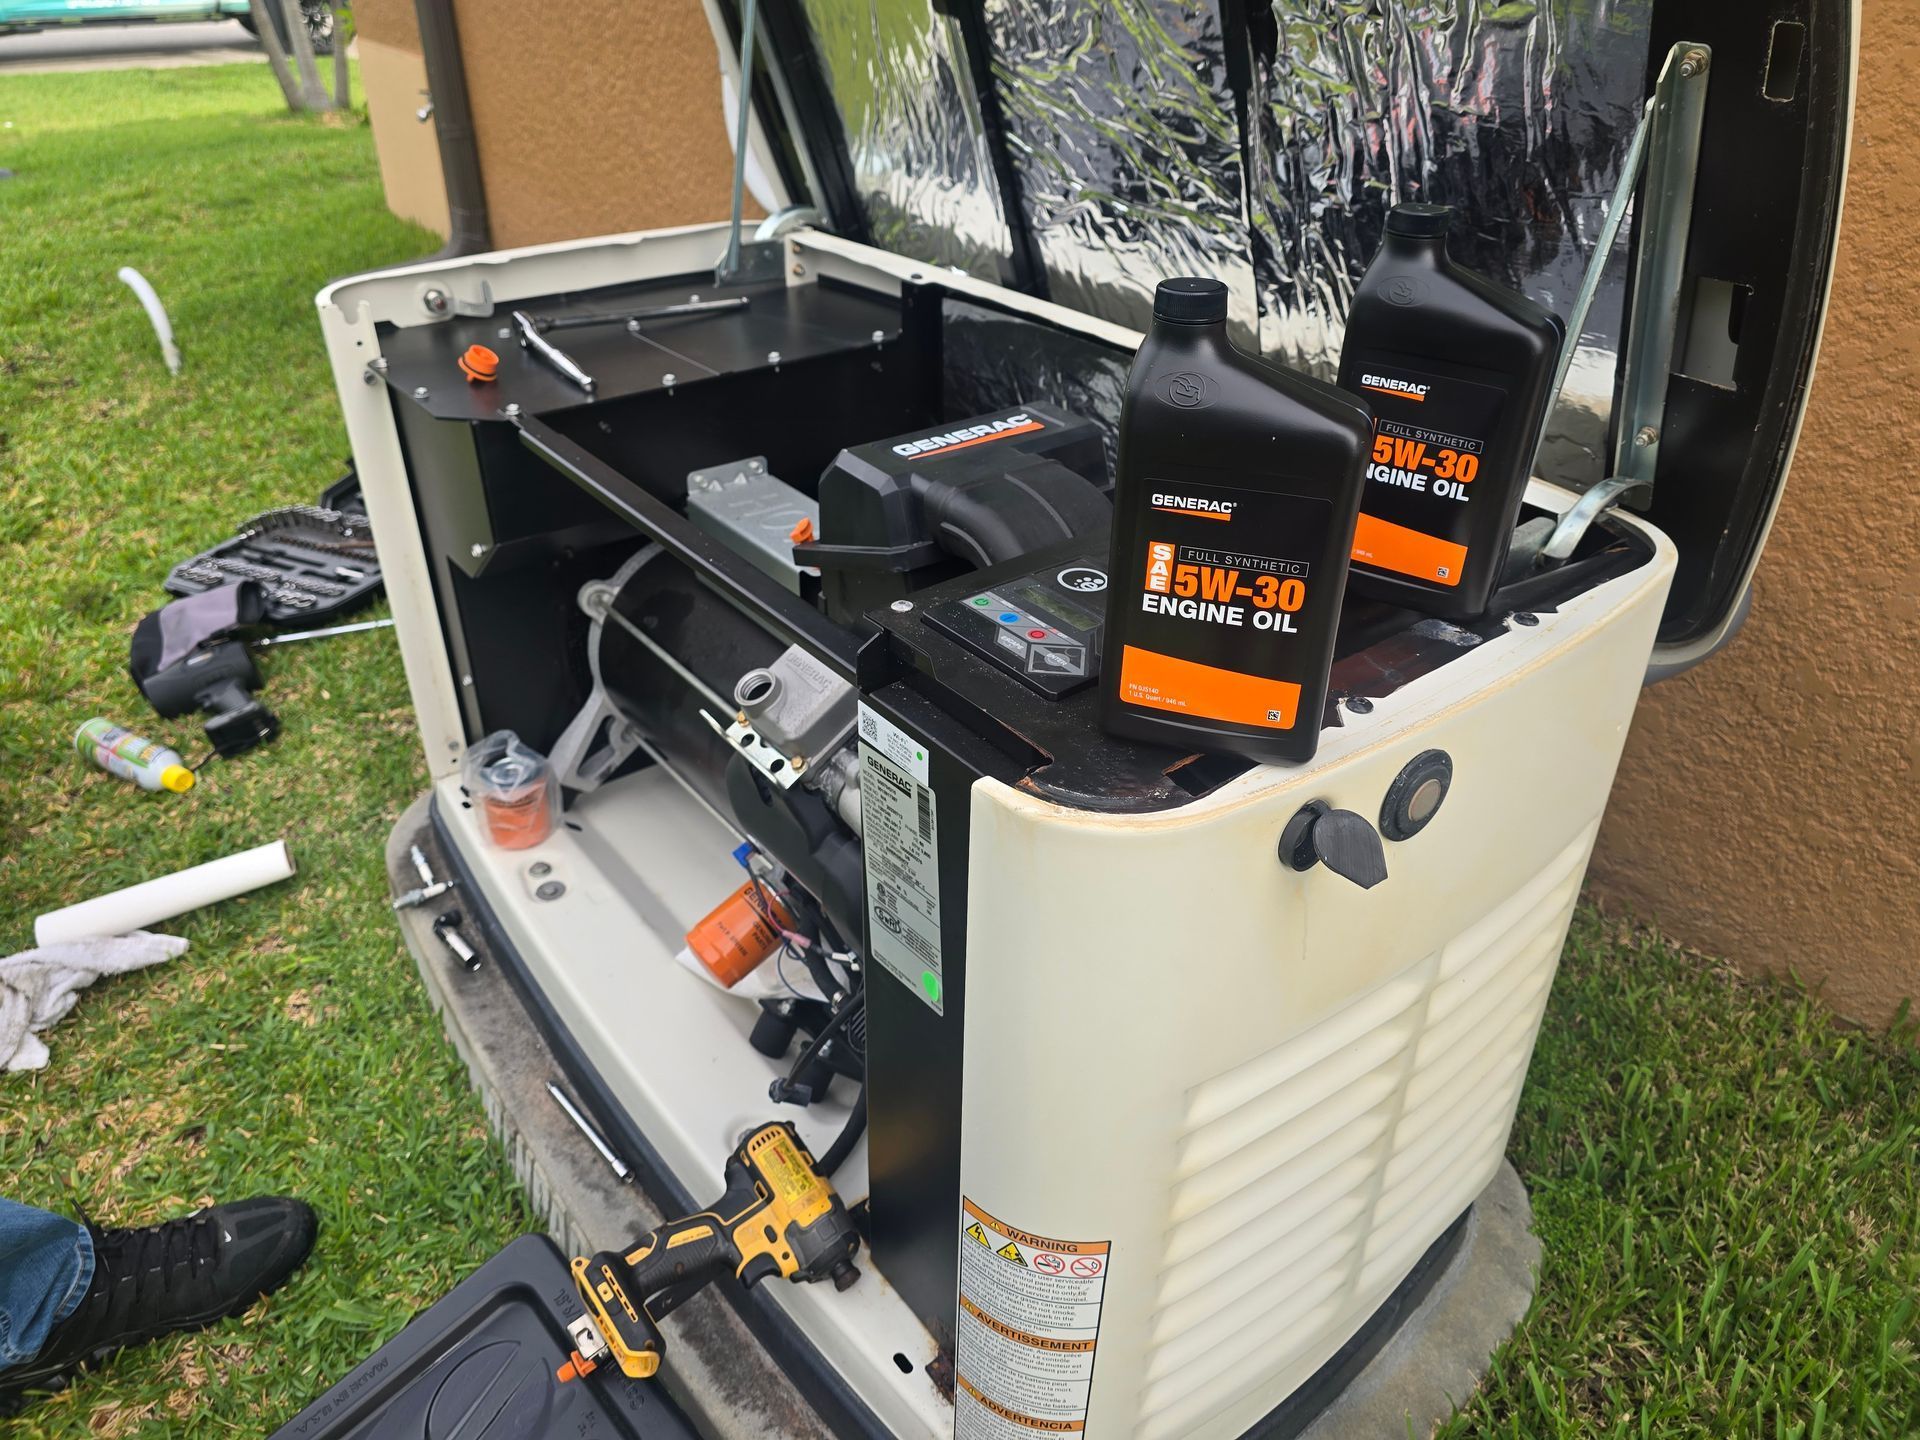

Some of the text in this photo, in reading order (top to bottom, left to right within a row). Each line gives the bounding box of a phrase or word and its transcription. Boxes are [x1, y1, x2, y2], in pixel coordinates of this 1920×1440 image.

[892, 414, 1032, 456] GENERAC
[1386, 424, 1476, 450] FULL SYNTHETIC
[1372, 434, 1479, 483] 5W-30
[1366, 463, 1469, 502] NGINE OIL
[1150, 544, 1172, 591] SAE
[1188, 550, 1300, 574] FULL SYNTHETIC
[1174, 564, 1306, 612] 5W-30
[1142, 594, 1297, 633] ENGINE OIL
[868, 756, 912, 792] GENERAC
[1007, 1228, 1078, 1252] WARNING
[996, 1274, 1024, 1292] qualified
[1025, 1288, 1050, 1300] service
[1009, 1269, 1033, 1284] control
[1034, 1279, 1054, 1289] panel
[1019, 1279, 1050, 1294] intended
[1025, 1270, 1036, 1278] No
[1037, 1274, 1052, 1282] user
[996, 1283, 1019, 1299] battery
[1019, 1294, 1039, 1305] gases
[1026, 1303, 1036, 1311] Do
[999, 1302, 1022, 1318] battery
[1008, 1301, 1026, 1313] cause
[1033, 1311, 1052, 1320] spark
[977, 1312, 1090, 1350] AVERTISSEMENT
[1033, 1325, 1051, 1333] harm
[348, 1356, 391, 1394] MADE
[980, 1397, 1072, 1429] ADVERTENCIA
